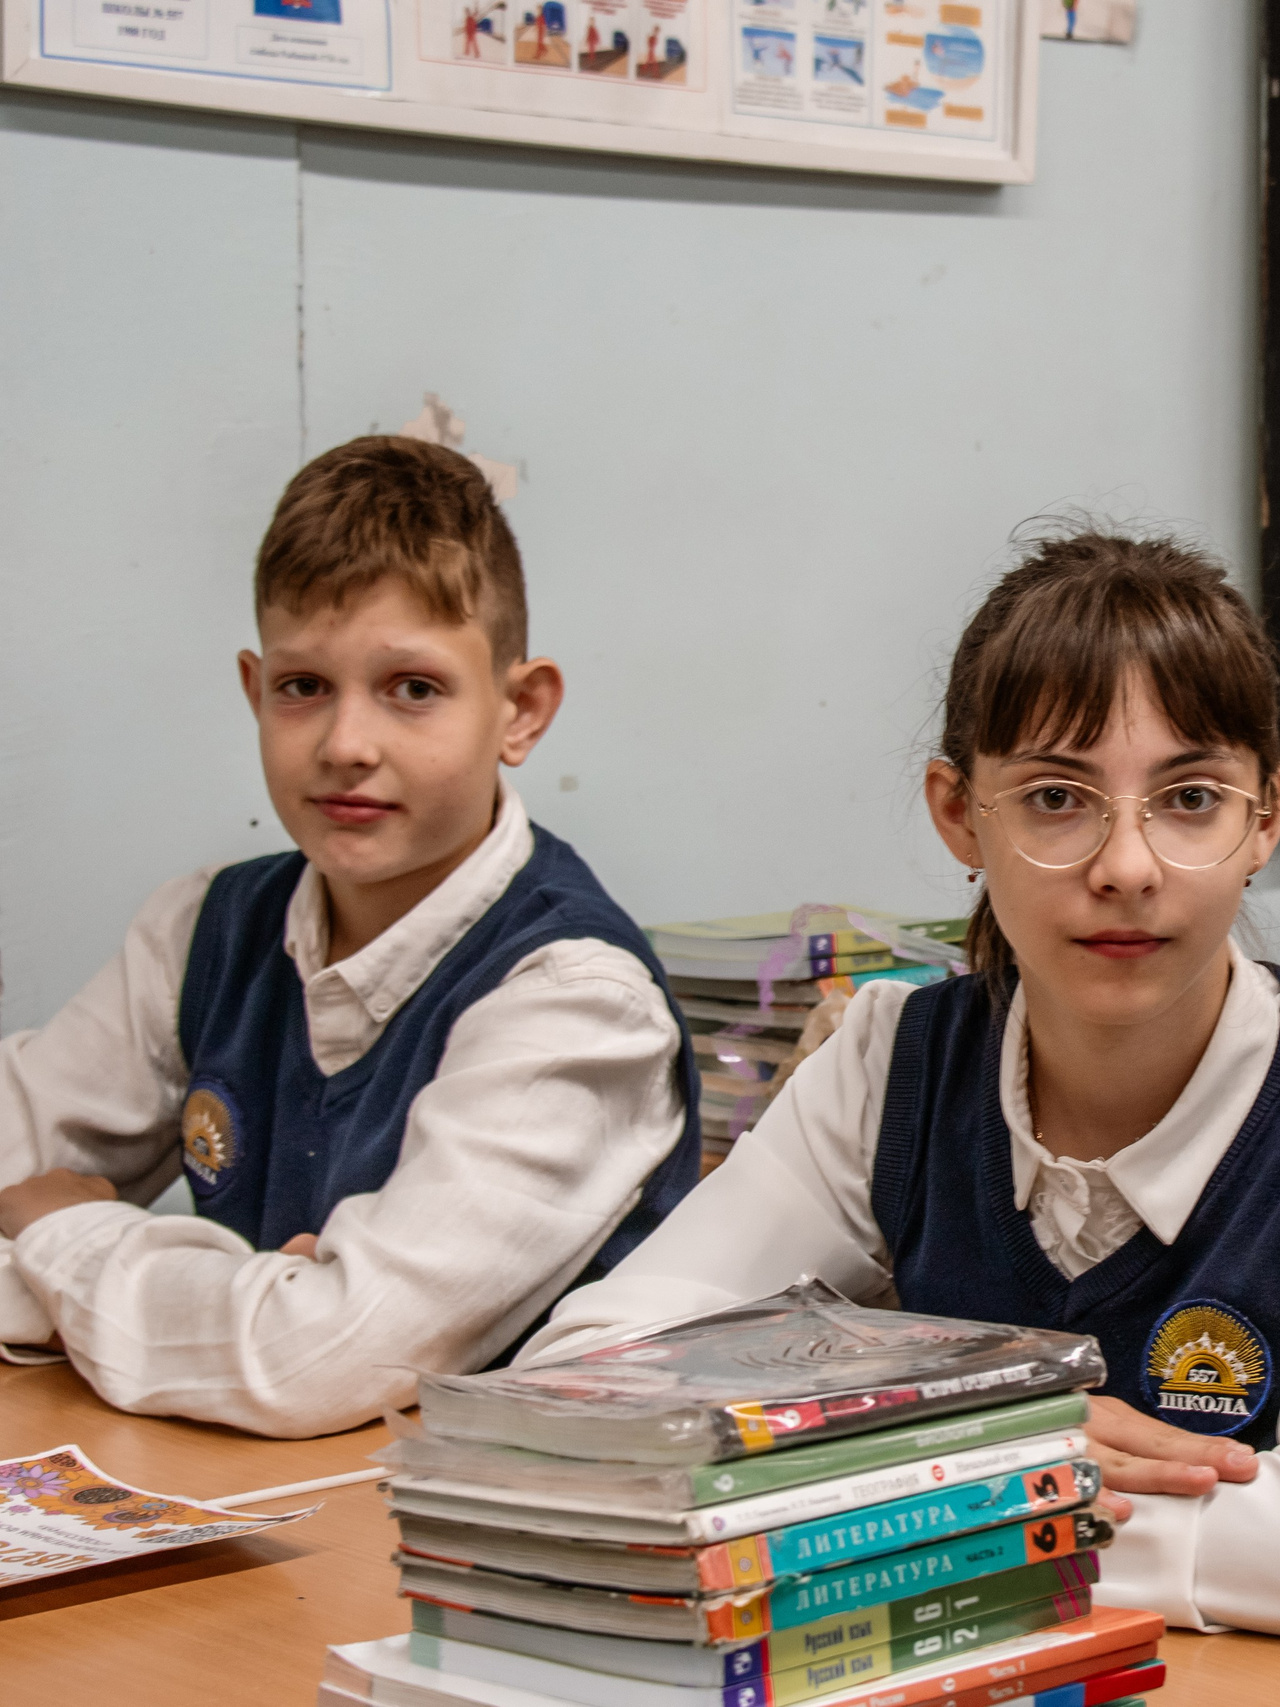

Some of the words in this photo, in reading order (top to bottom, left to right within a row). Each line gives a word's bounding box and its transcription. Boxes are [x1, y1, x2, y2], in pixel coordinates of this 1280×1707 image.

[1188, 1369, 1219, 1384] 557
[1157, 1392, 1252, 1416] ШКОЛА
[797, 1503, 957, 1560] ЛИТЕРАТУРА
[796, 1554, 954, 1611] ЛИТЕРАТУРА
[1032, 1522, 1058, 1553] 6
[914, 1602, 943, 1623] 6
[953, 1596, 980, 1610] 1
[914, 1635, 943, 1657] 6
[953, 1625, 980, 1645] 2
